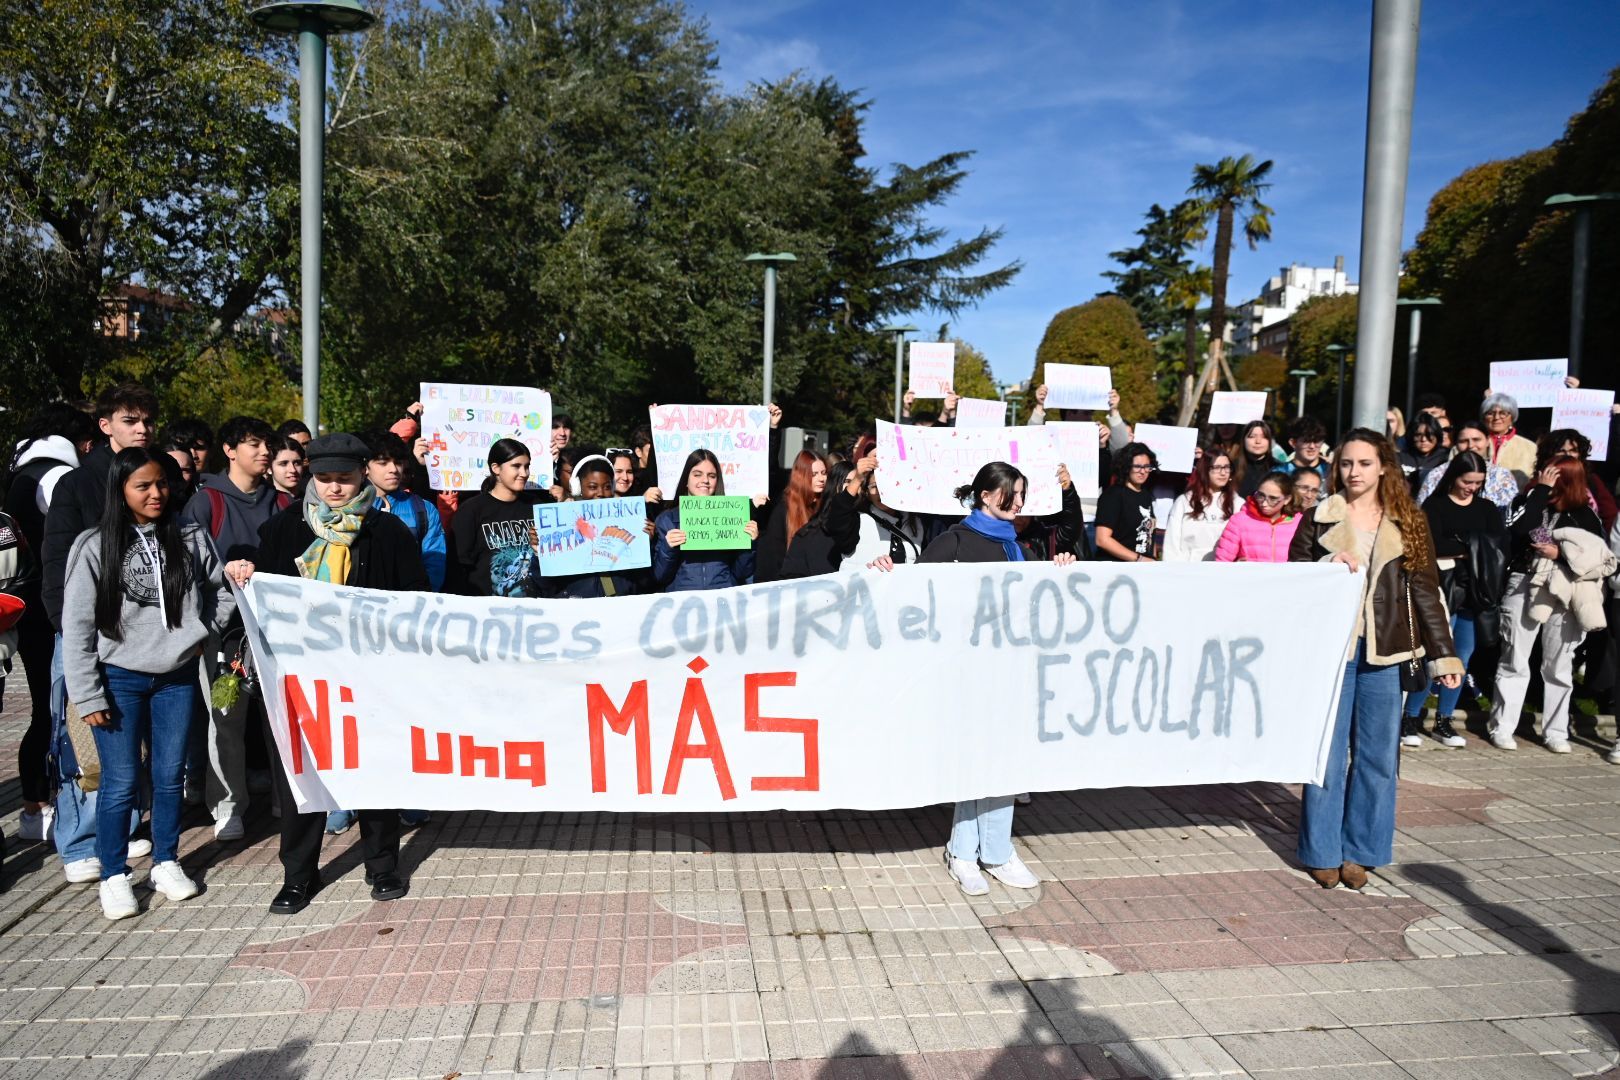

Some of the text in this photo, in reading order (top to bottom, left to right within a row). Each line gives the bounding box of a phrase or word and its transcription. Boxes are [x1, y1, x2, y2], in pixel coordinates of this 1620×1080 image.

[428, 387, 448, 400] EL
[938, 381, 951, 394] YA
[449, 409, 520, 427] DESTROZA
[654, 406, 747, 431] SANDRA
[654, 431, 768, 453] NO ESTÁ SOLA
[431, 455, 462, 468] STOP
[431, 469, 473, 488] STOP
[682, 500, 694, 510] NO
[694, 500, 703, 510] AL
[539, 506, 567, 529] EL
[686, 517, 711, 526] NUNCA
[712, 516, 719, 526] TE
[540, 528, 586, 556] MATA
[688, 530, 713, 542] REMOS,
[638, 572, 882, 658] CONTRA
[898, 578, 942, 643] el
[969, 571, 1140, 648] ACOSO
[1037, 635, 1264, 743] ESCOLAR
[284, 674, 359, 775] Ni
[585, 655, 820, 801] MÁS
